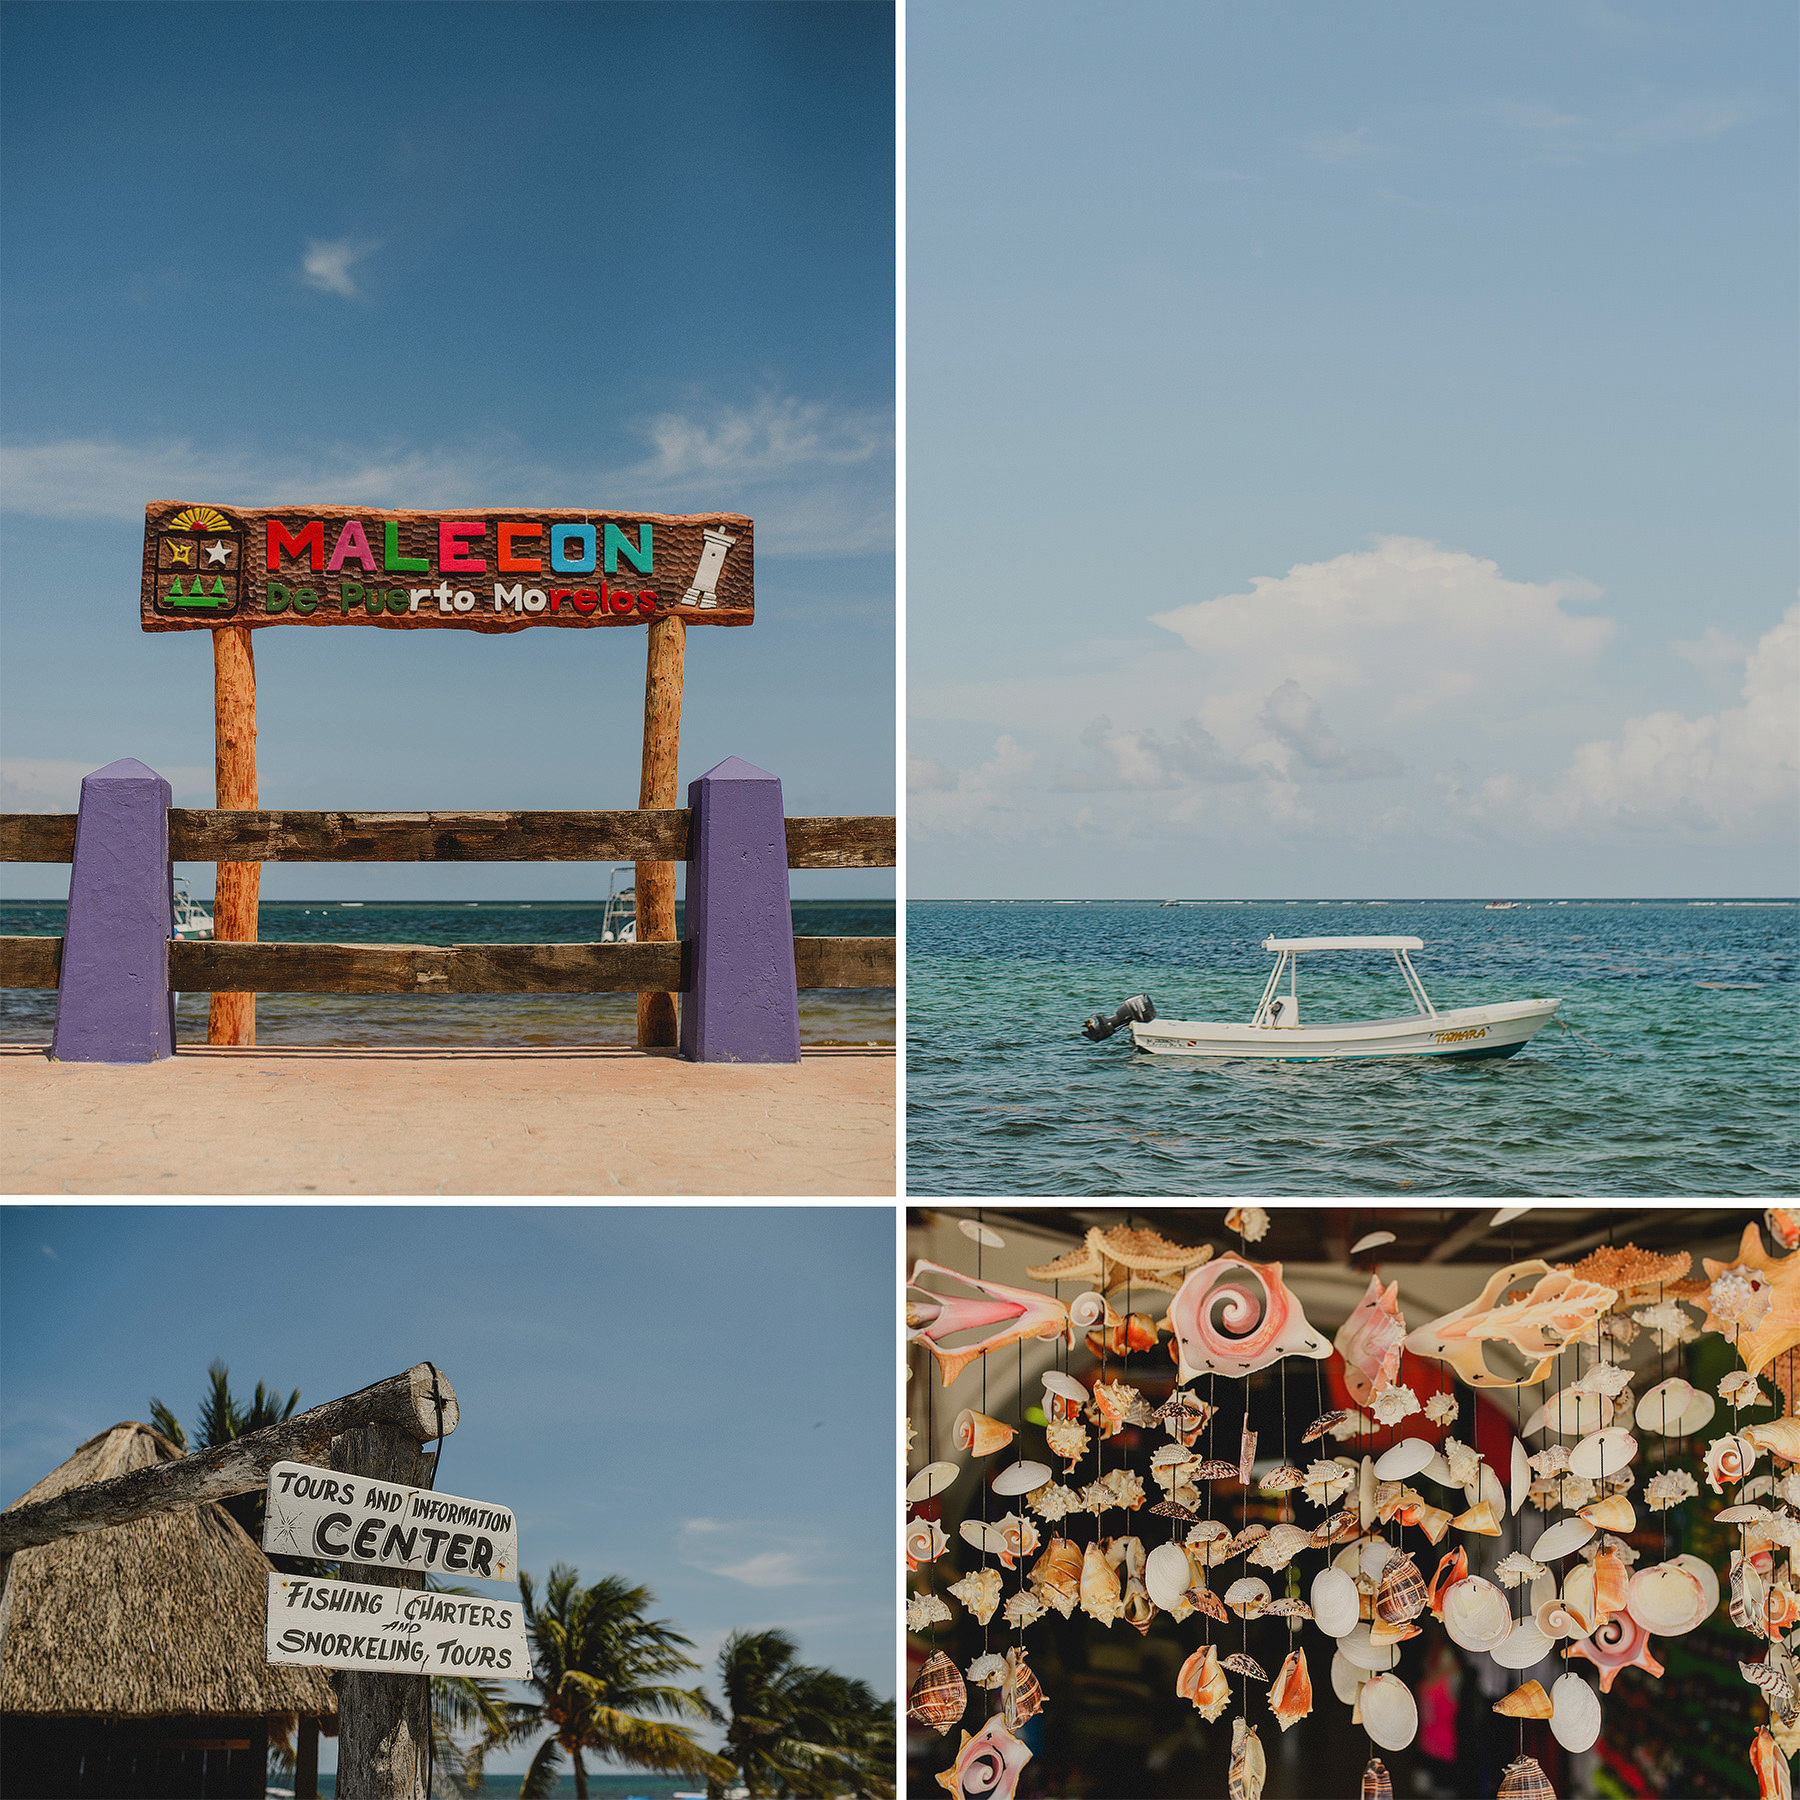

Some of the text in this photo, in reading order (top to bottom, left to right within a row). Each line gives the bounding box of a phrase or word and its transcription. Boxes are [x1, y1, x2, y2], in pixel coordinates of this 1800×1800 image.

[266, 520, 653, 574] MALECON
[266, 579, 658, 614] De Puerto Morelos
[277, 1472, 512, 1533] TOURS AND INFORMATION
[313, 1512, 494, 1577] CENTER
[286, 1581, 512, 1629] FISHING CHARTERS
[381, 1620, 422, 1634] AND
[276, 1629, 512, 1669] SNORKELING TOURS
